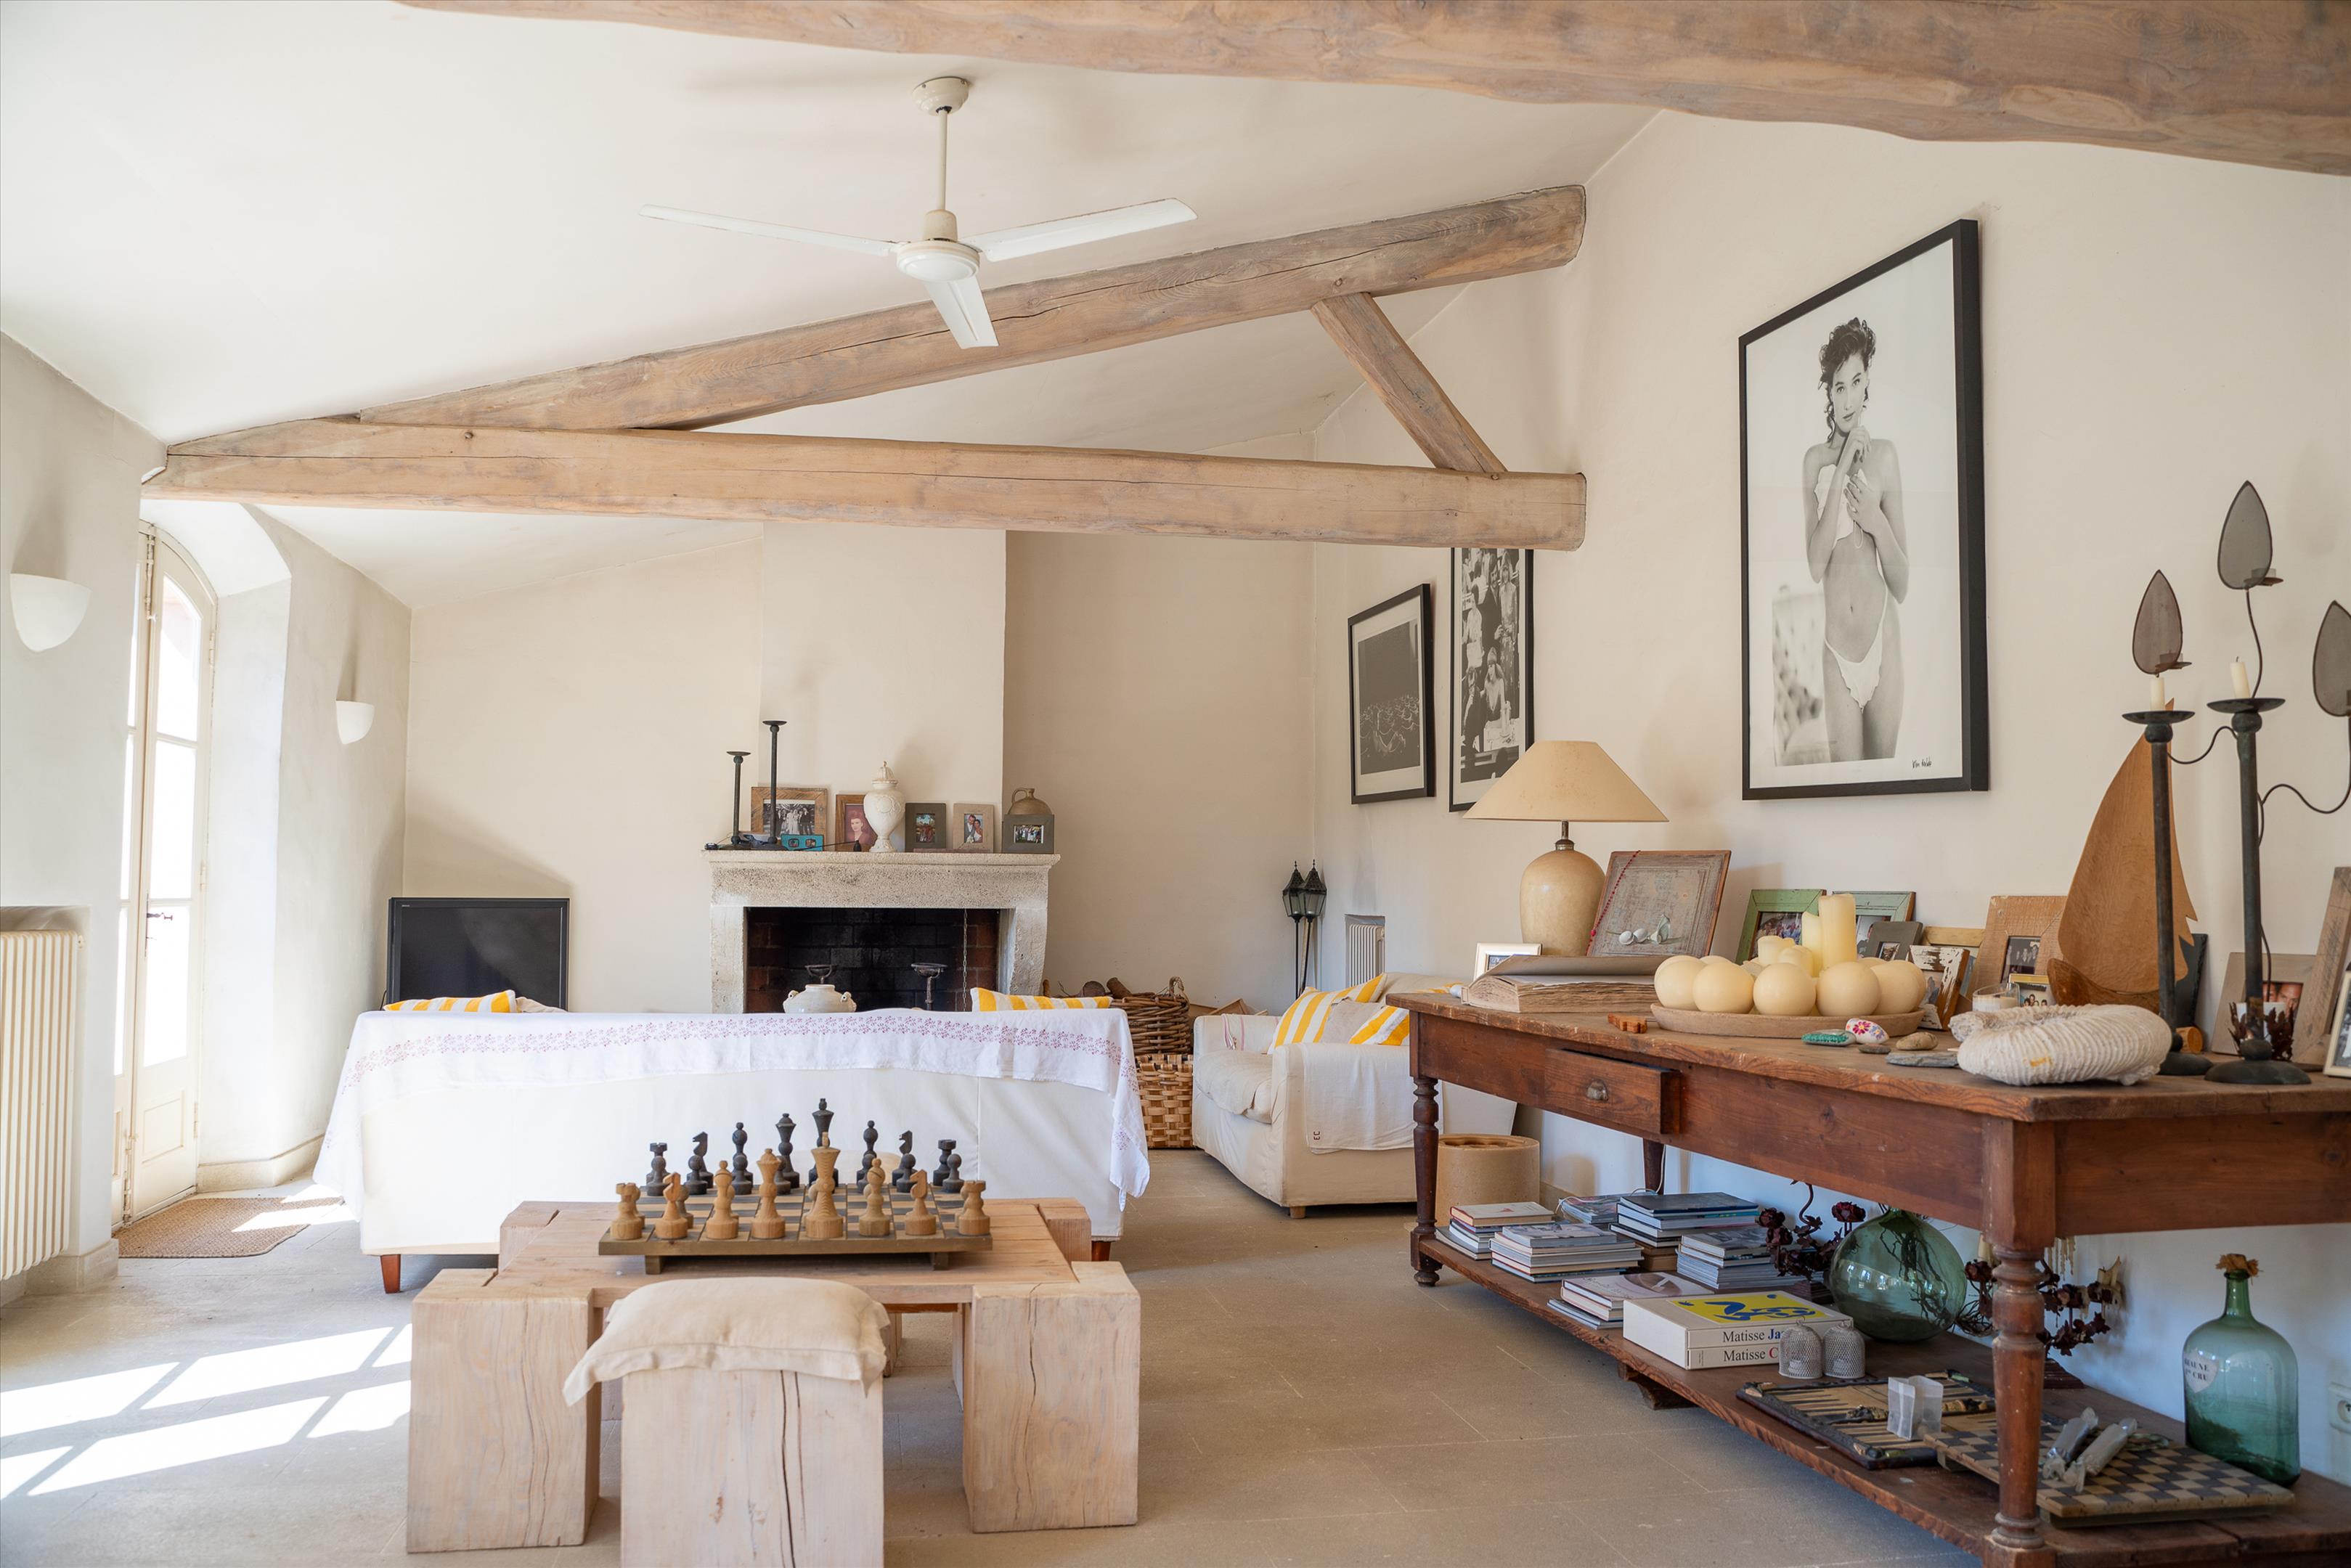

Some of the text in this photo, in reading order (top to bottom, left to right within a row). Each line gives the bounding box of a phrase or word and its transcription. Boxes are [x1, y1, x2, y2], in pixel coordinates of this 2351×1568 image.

[1722, 1328, 1784, 1343] Matisse Ja
[1724, 1348, 1766, 1362] Matisse
